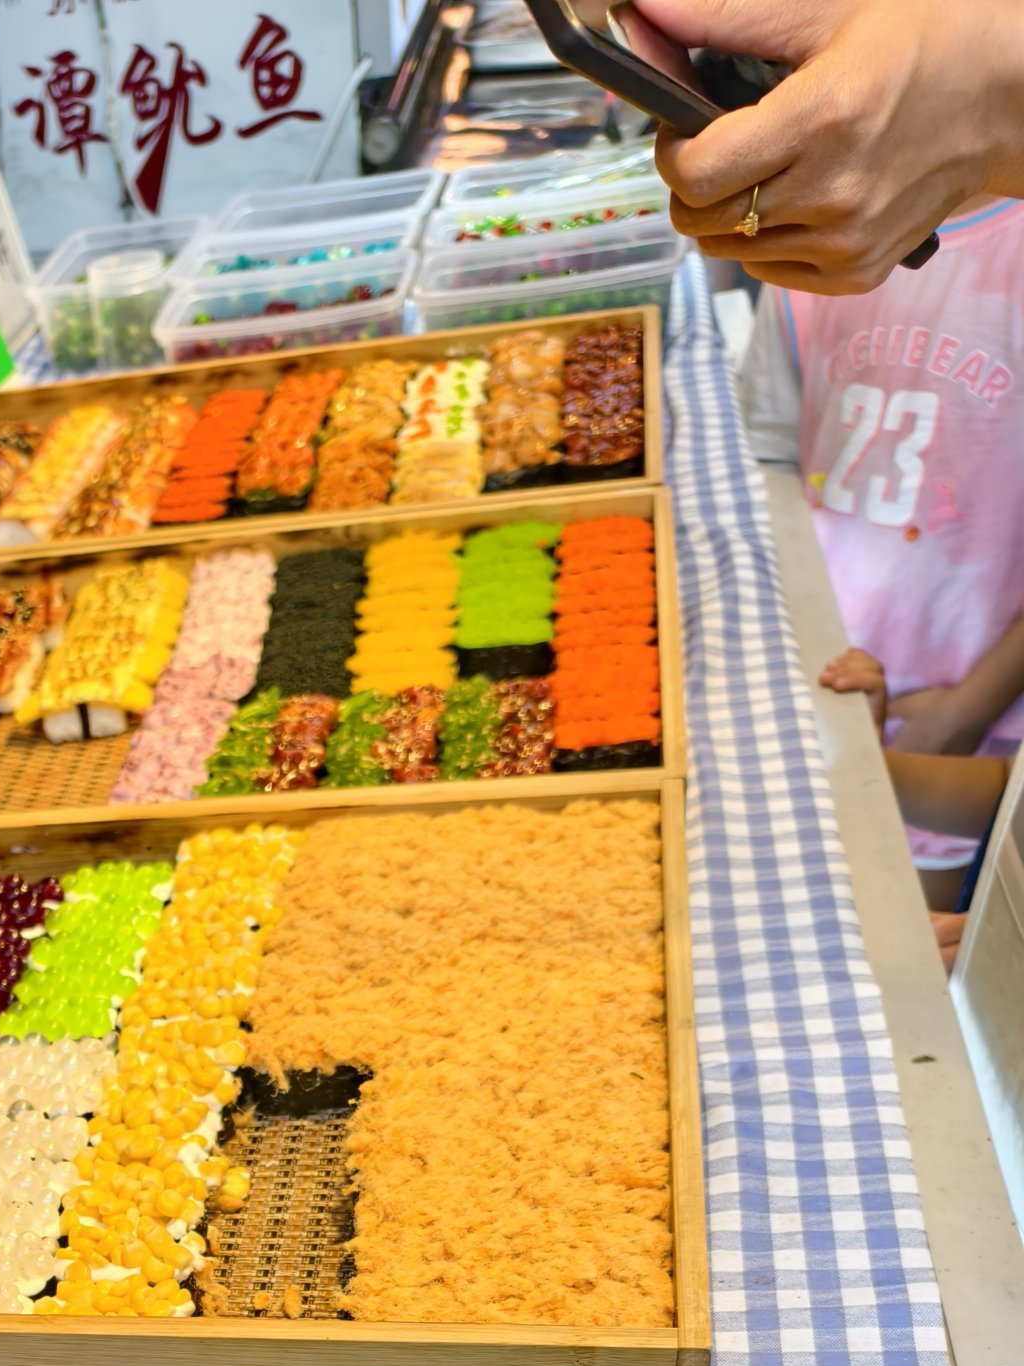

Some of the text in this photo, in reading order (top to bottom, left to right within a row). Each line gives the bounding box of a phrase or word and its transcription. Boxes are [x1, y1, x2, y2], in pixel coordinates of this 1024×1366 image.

[12, 13, 324, 216] 谭鱿鱼
[823, 382, 941, 528] 23
